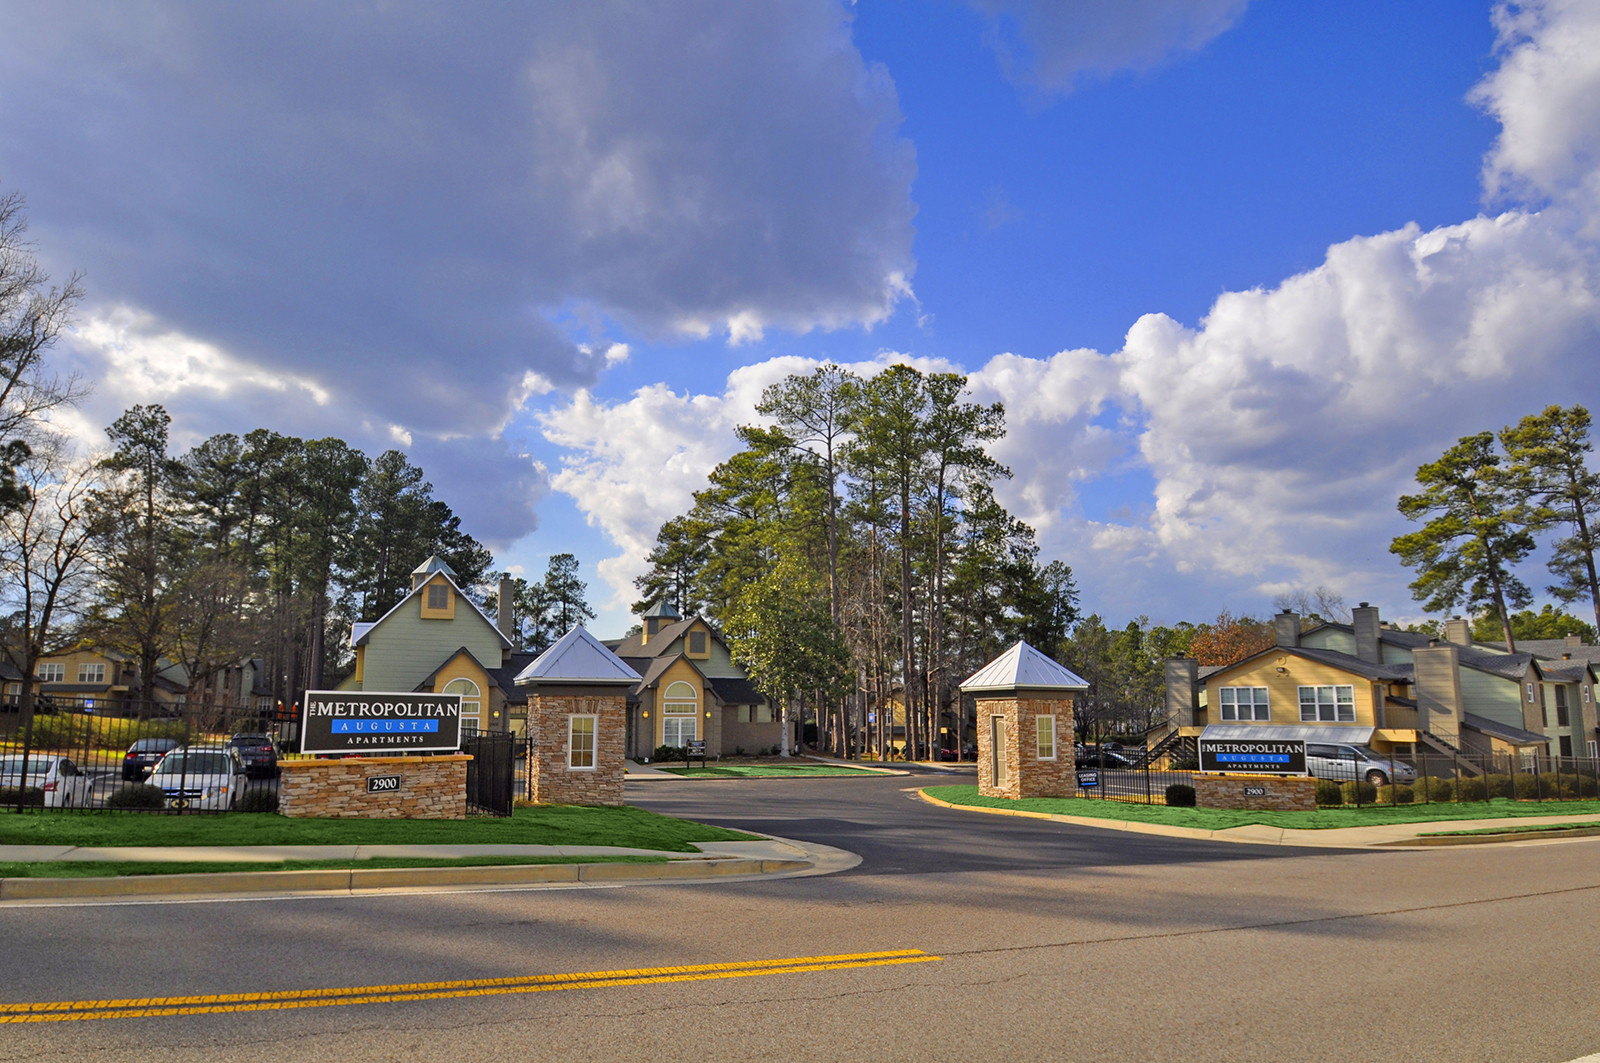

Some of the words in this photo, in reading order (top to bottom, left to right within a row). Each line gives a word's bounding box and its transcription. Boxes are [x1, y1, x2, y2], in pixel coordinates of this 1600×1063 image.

[309, 701, 317, 717] THE
[317, 702, 458, 717] METROPOLITAN
[341, 721, 431, 731] AUGUSTA
[347, 735, 424, 744] APARTMENTS
[1206, 743, 1303, 753] METROPOLITAN
[372, 778, 397, 790] 2900
